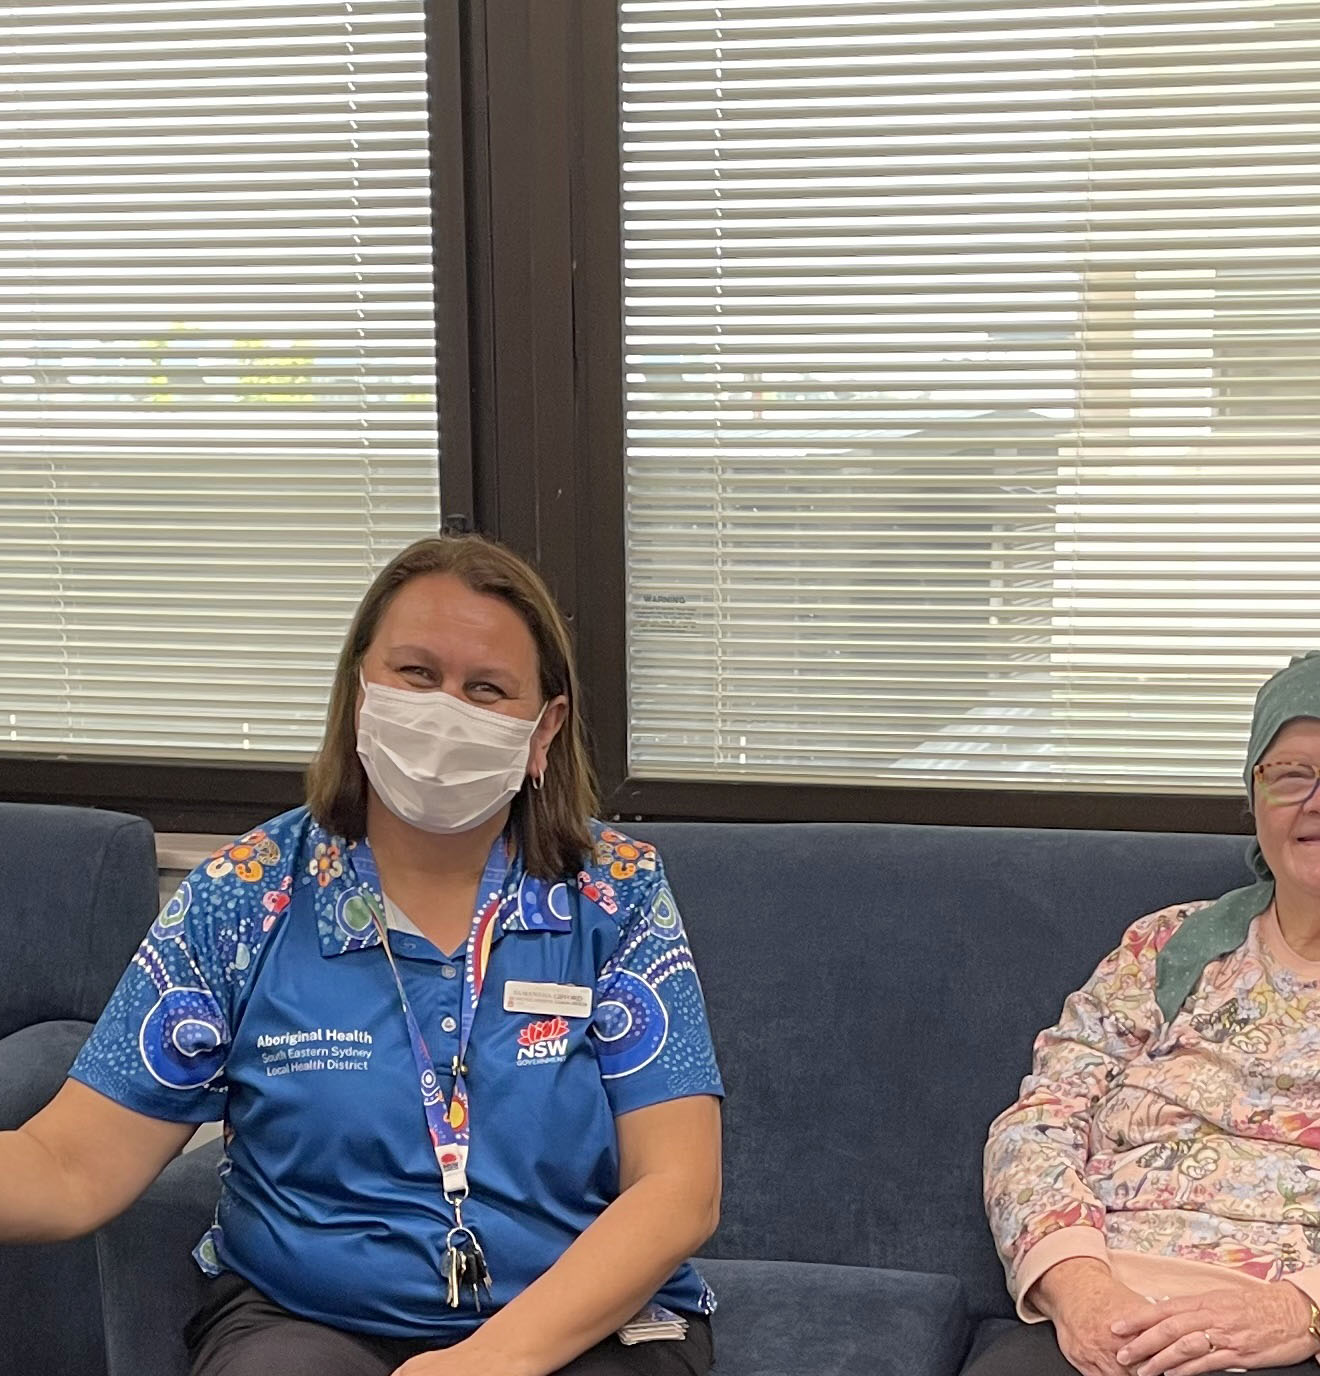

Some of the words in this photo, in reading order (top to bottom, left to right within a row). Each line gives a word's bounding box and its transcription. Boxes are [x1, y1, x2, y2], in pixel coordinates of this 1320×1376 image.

[257, 1028, 322, 1048] Aboriginal
[326, 1029, 373, 1044] Health
[262, 1051, 287, 1063] South
[288, 1047, 328, 1059] Eastern
[331, 1046, 372, 1059] Sydney
[517, 1039, 568, 1060] NSW
[266, 1064, 289, 1077] Local
[290, 1060, 324, 1072] Health
[327, 1060, 368, 1070] District
